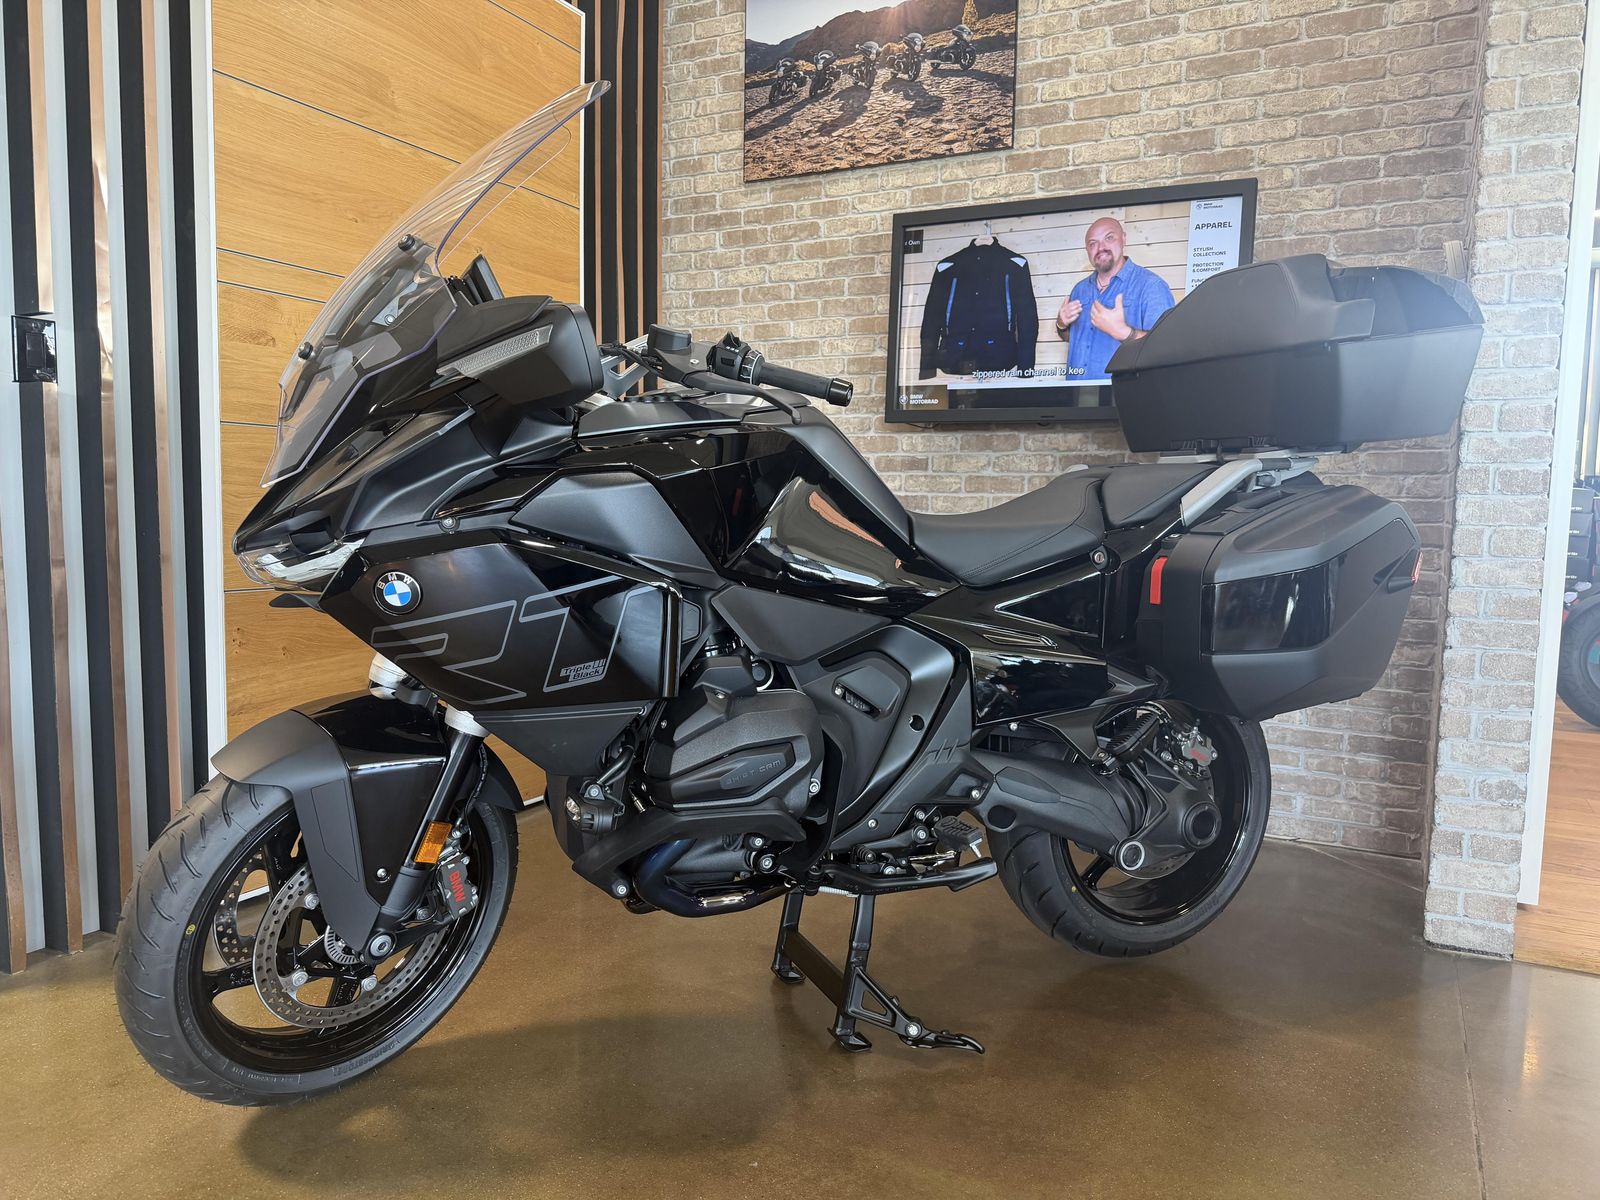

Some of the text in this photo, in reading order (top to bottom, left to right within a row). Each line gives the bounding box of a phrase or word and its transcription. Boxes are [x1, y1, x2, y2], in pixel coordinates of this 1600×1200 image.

[1195, 221, 1233, 230] APPAREL
[972, 366, 1085, 380] zippered rain channel to kee
[564, 664, 591, 675] Triple
[573, 668, 600, 680] Black
[449, 870, 466, 903] BMW
